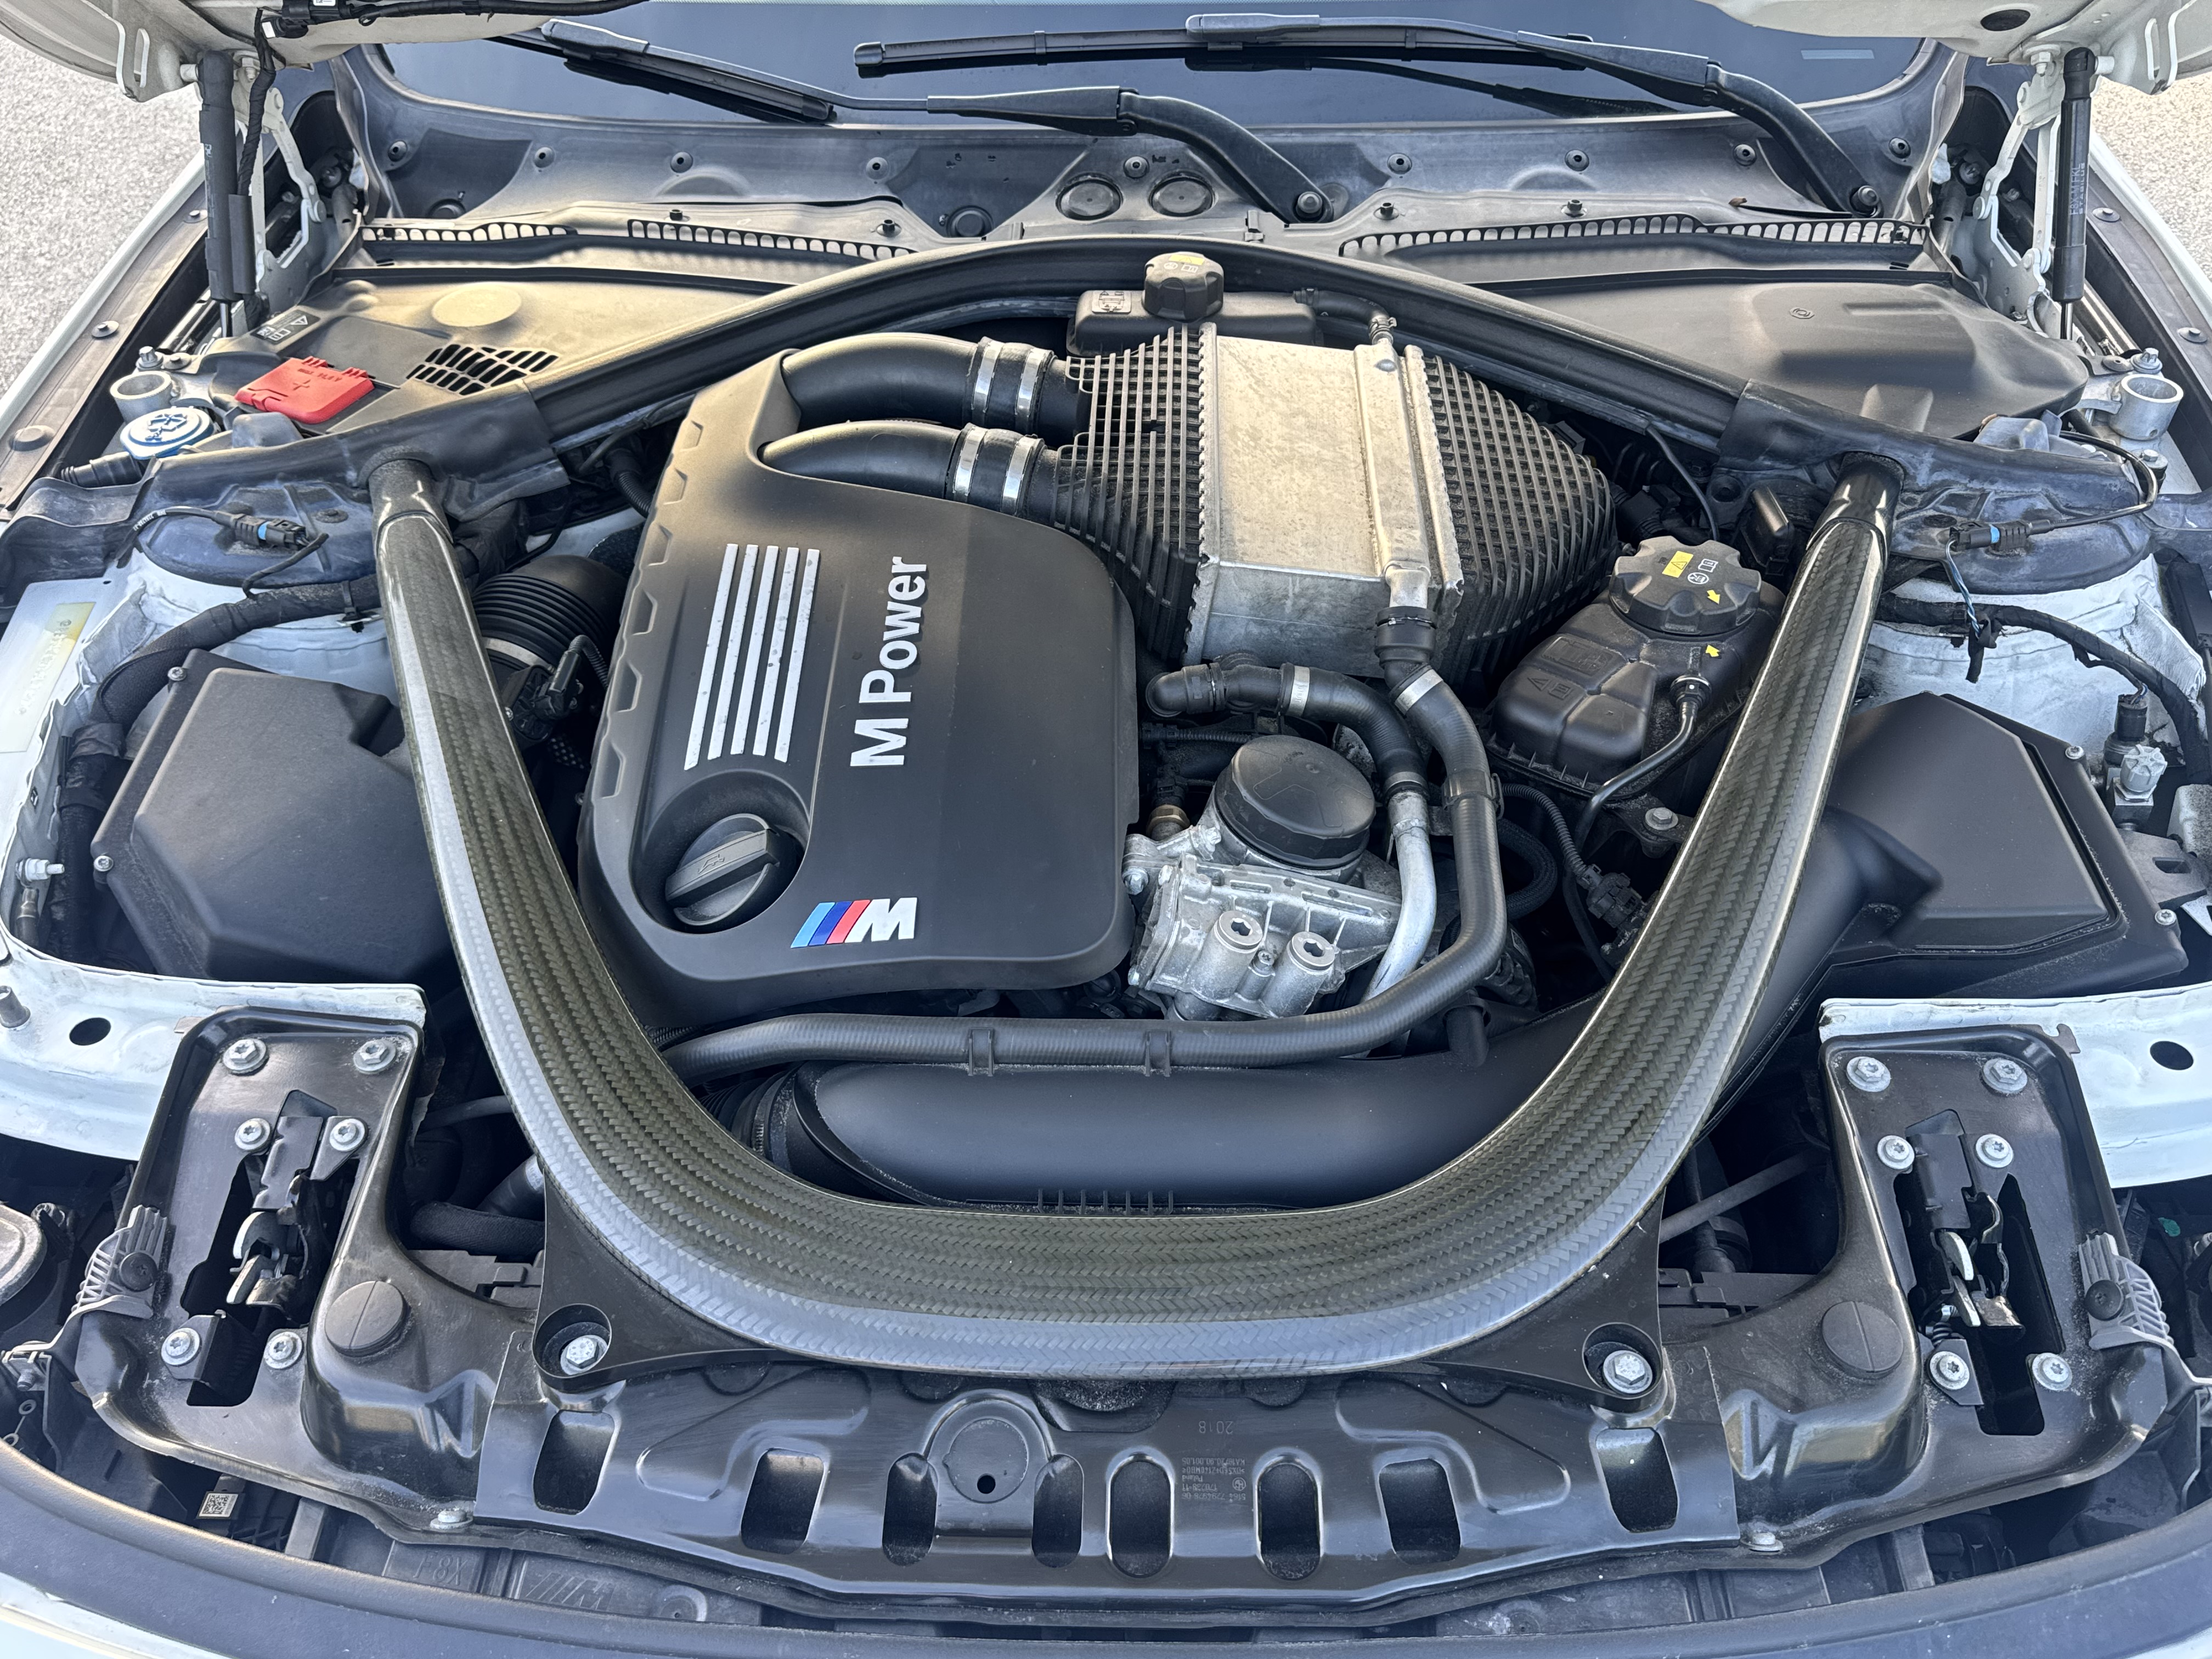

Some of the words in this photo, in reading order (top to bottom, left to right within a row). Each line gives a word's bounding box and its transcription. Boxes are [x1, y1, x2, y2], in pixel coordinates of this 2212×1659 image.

[2071, 163, 2081, 183] FKL
[859, 556, 927, 704] Power
[850, 718, 909, 766] M
[1198, 1420, 1234, 1435] 2018
[1182, 1474, 1203, 1482] Poland
[413, 1550, 469, 1586] F8X
